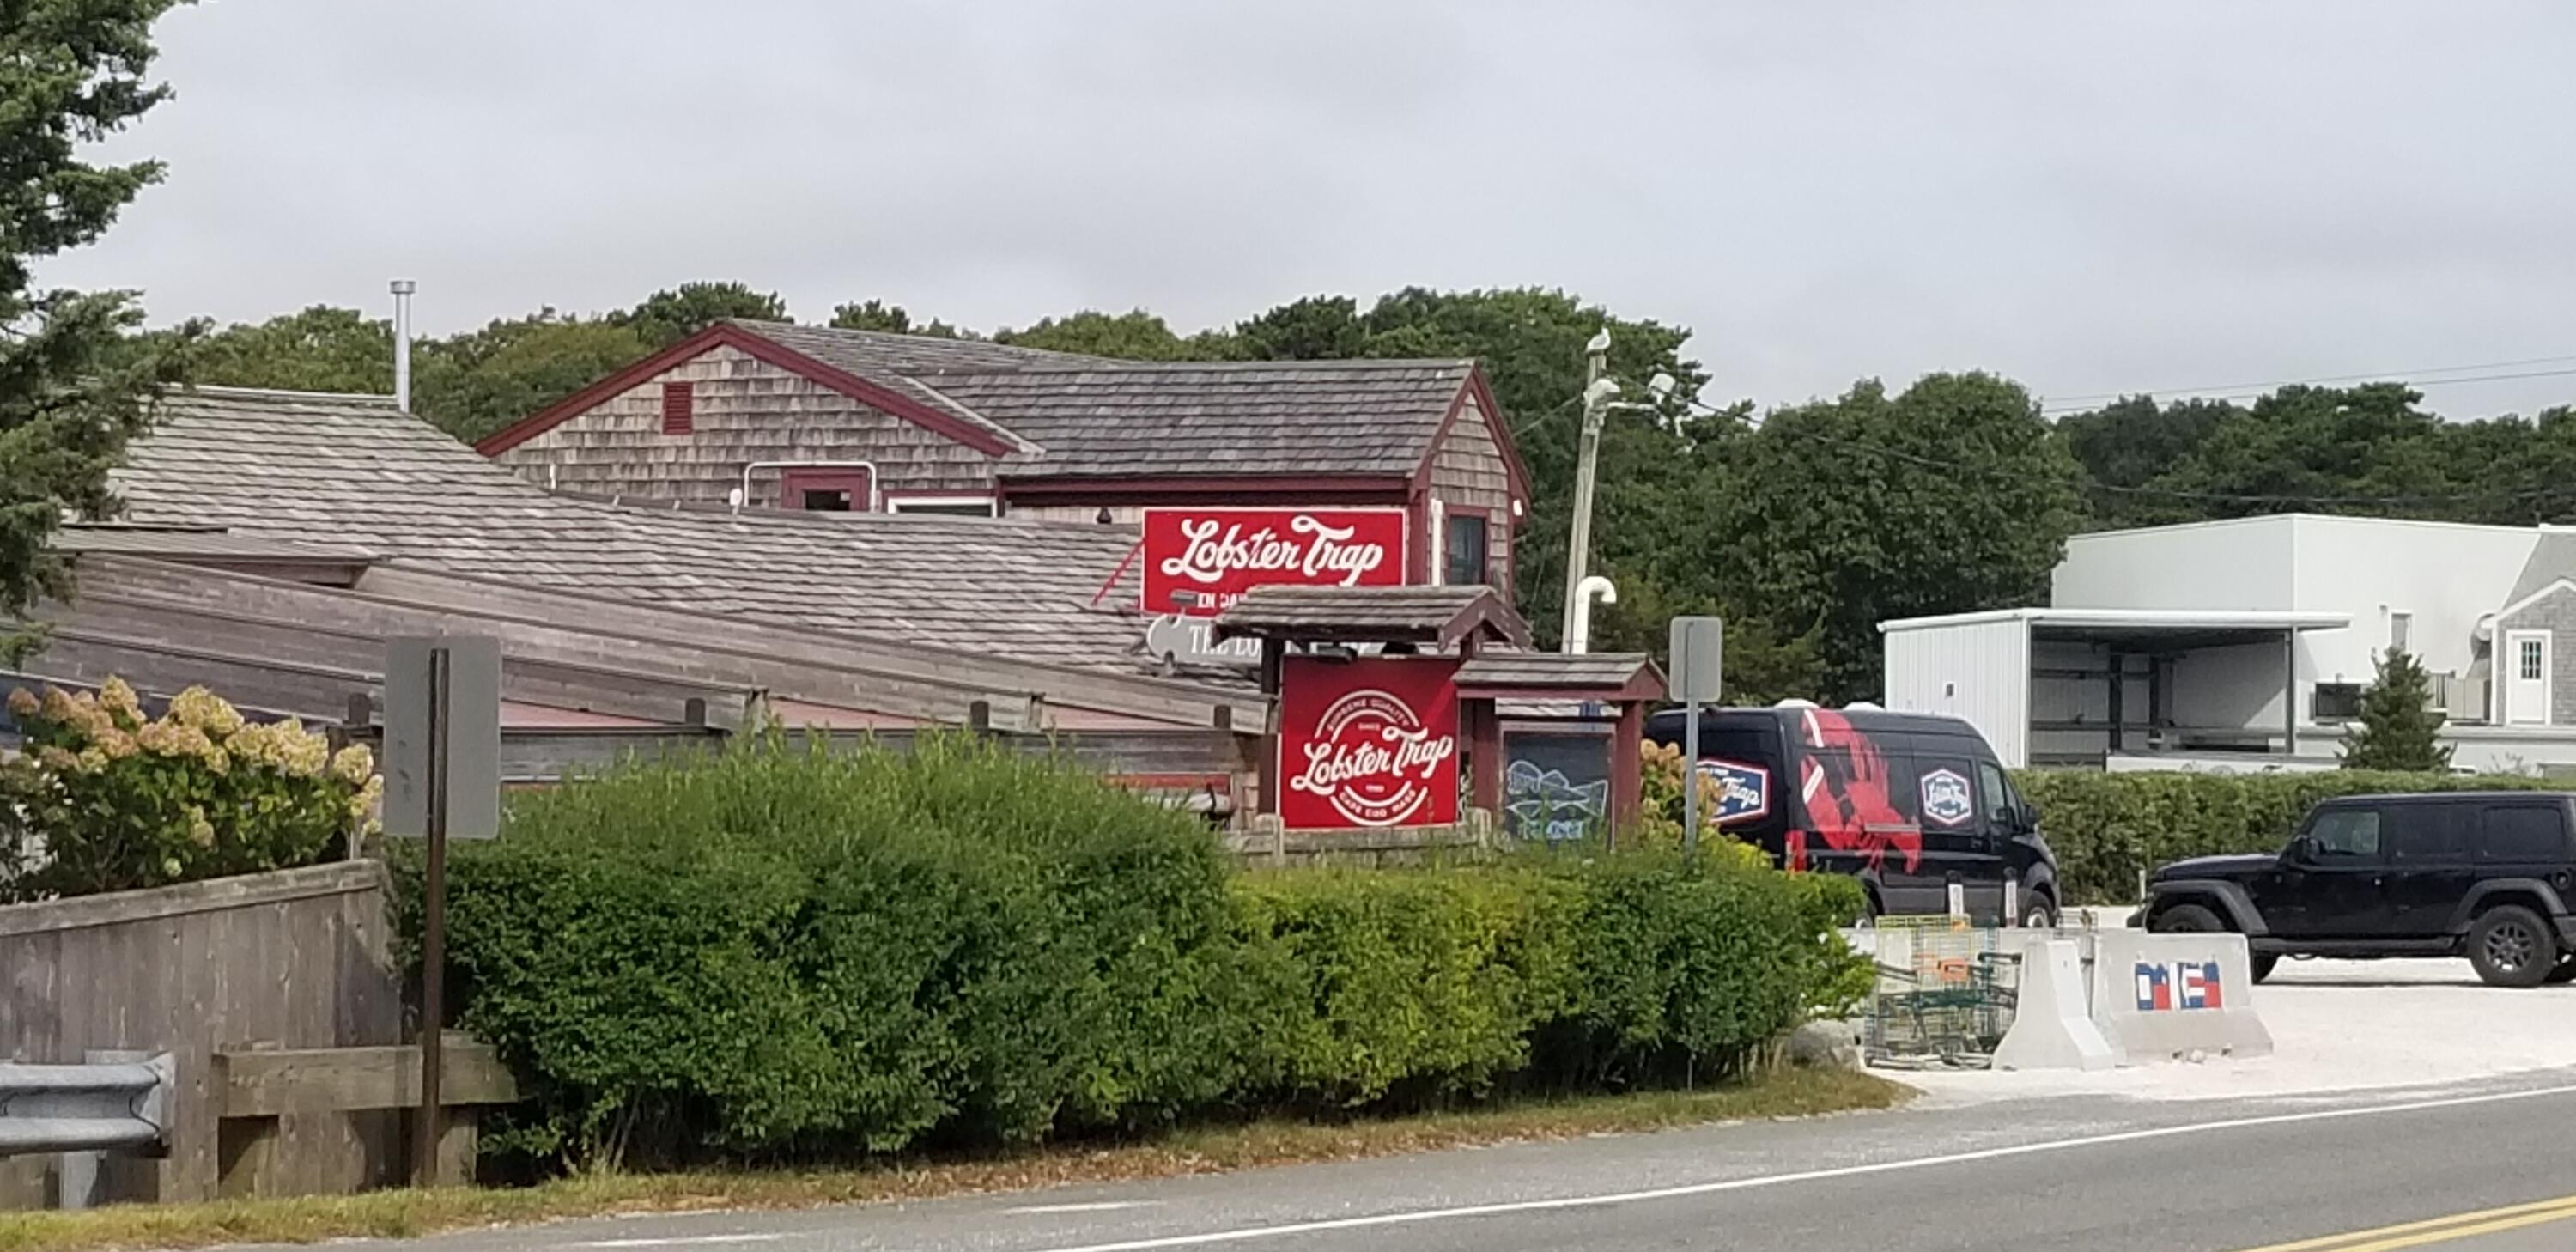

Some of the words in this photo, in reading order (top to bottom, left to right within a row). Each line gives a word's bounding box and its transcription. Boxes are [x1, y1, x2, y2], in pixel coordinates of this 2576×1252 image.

[1161, 518, 1300, 583] Lobster
[1291, 515, 1384, 587] Trap
[1290, 741, 1391, 796] Lobster
[1382, 726, 1454, 779] Trap
[1340, 792, 1363, 814] CAPE
[1720, 777, 1760, 809] Trap
